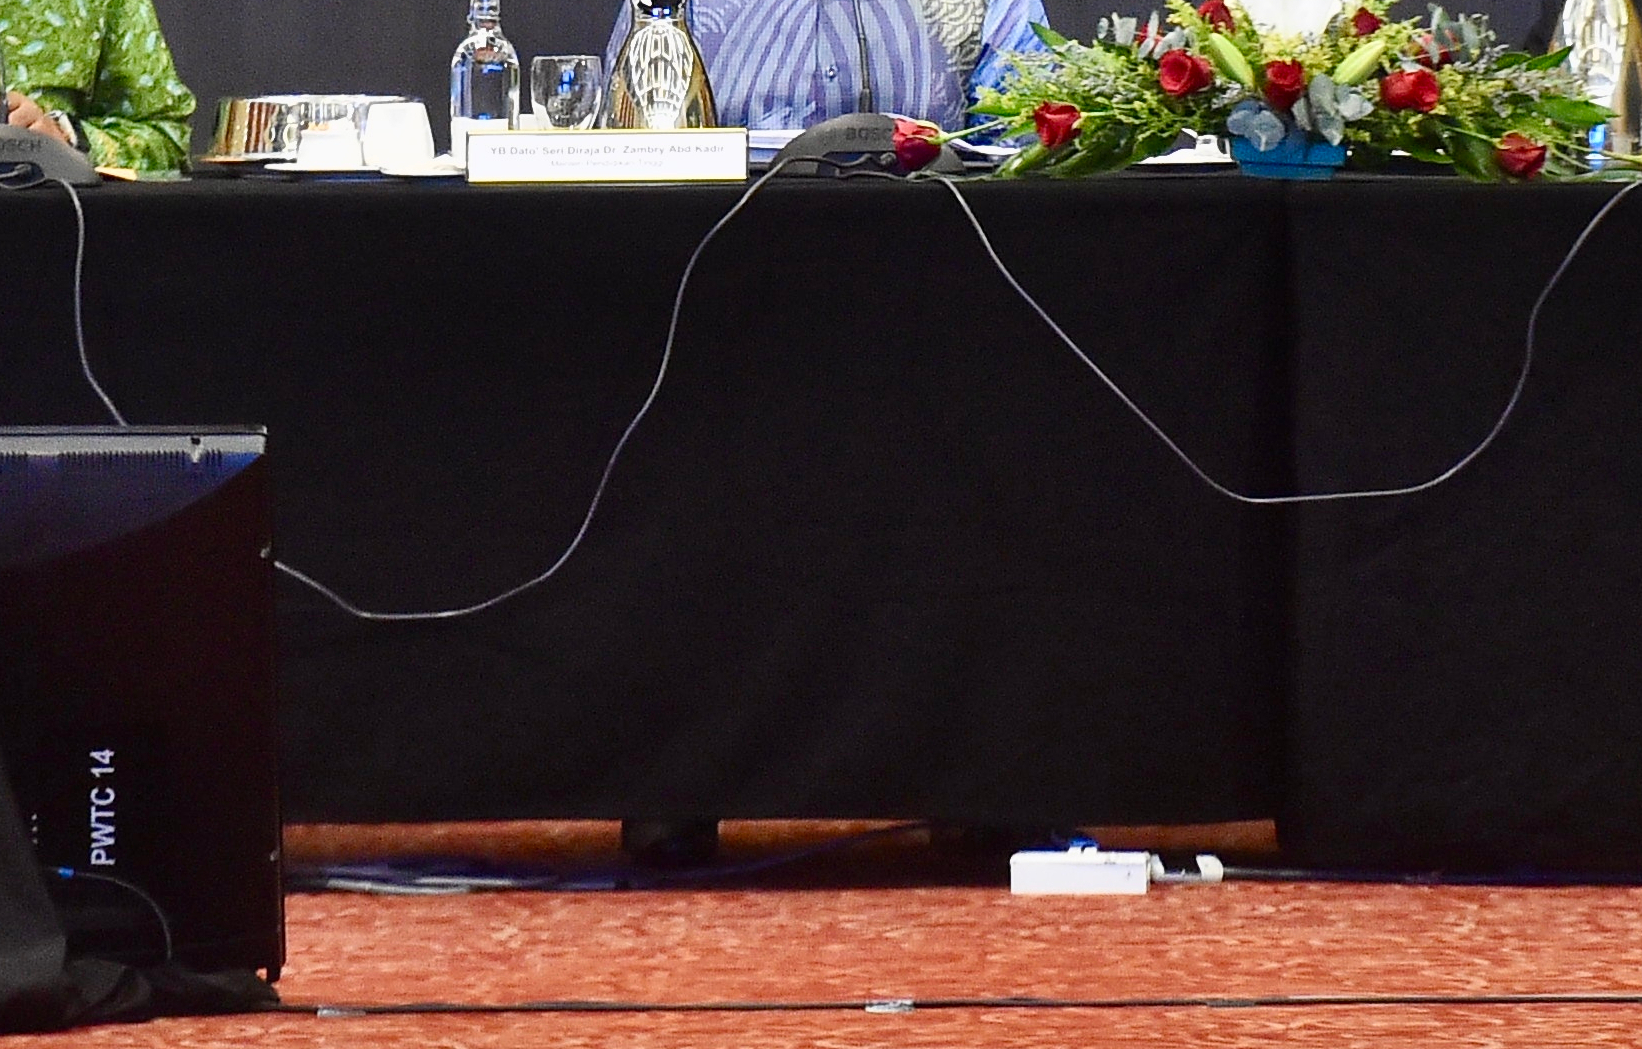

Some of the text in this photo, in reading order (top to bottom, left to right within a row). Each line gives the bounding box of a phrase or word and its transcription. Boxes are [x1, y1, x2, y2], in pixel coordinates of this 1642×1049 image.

[490, 146, 506, 155] YB
[567, 145, 600, 156] Diraja
[622, 145, 664, 155] Zambry
[89, 748, 116, 866] PWTC 14
